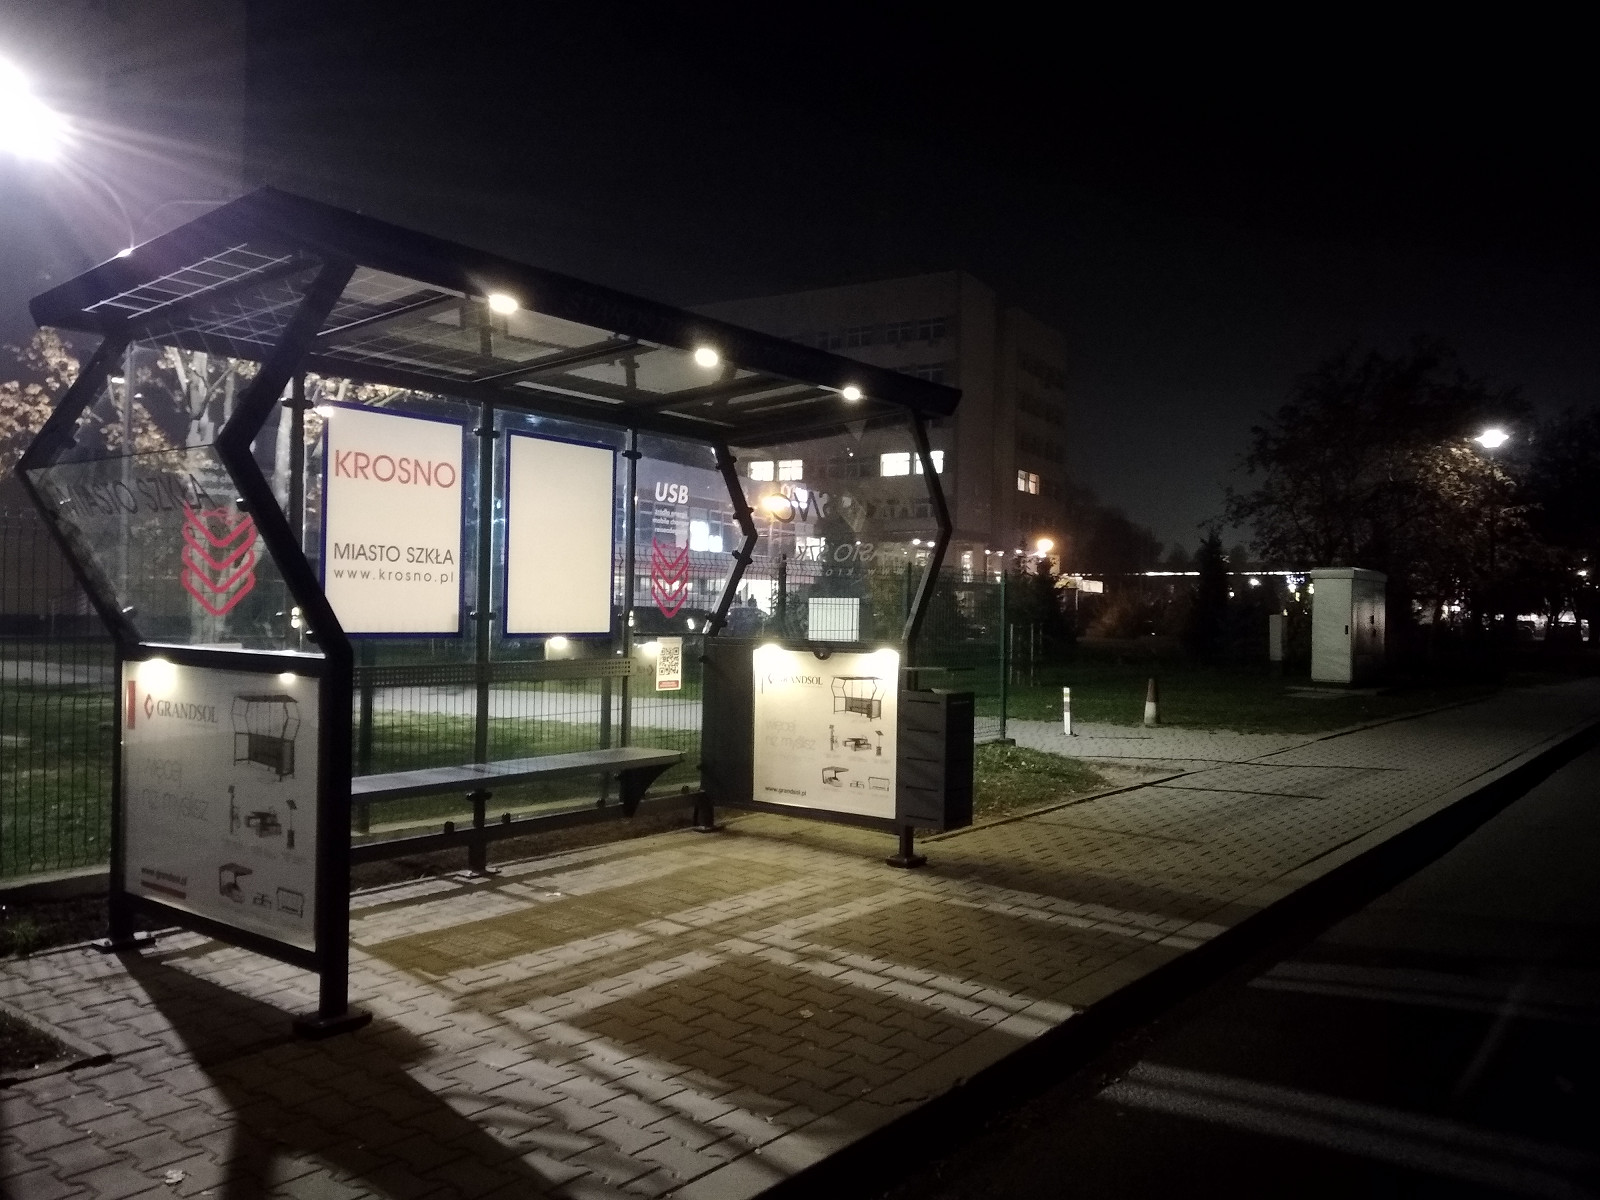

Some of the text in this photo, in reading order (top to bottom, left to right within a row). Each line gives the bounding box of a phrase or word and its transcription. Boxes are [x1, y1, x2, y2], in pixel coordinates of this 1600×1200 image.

[335, 450, 456, 489] KROSNO
[655, 481, 689, 504] USB
[334, 542, 454, 565] MIASTO SZKŁA
[333, 569, 454, 584] www.krosno.pl
[157, 700, 218, 723] GRANDSOL
